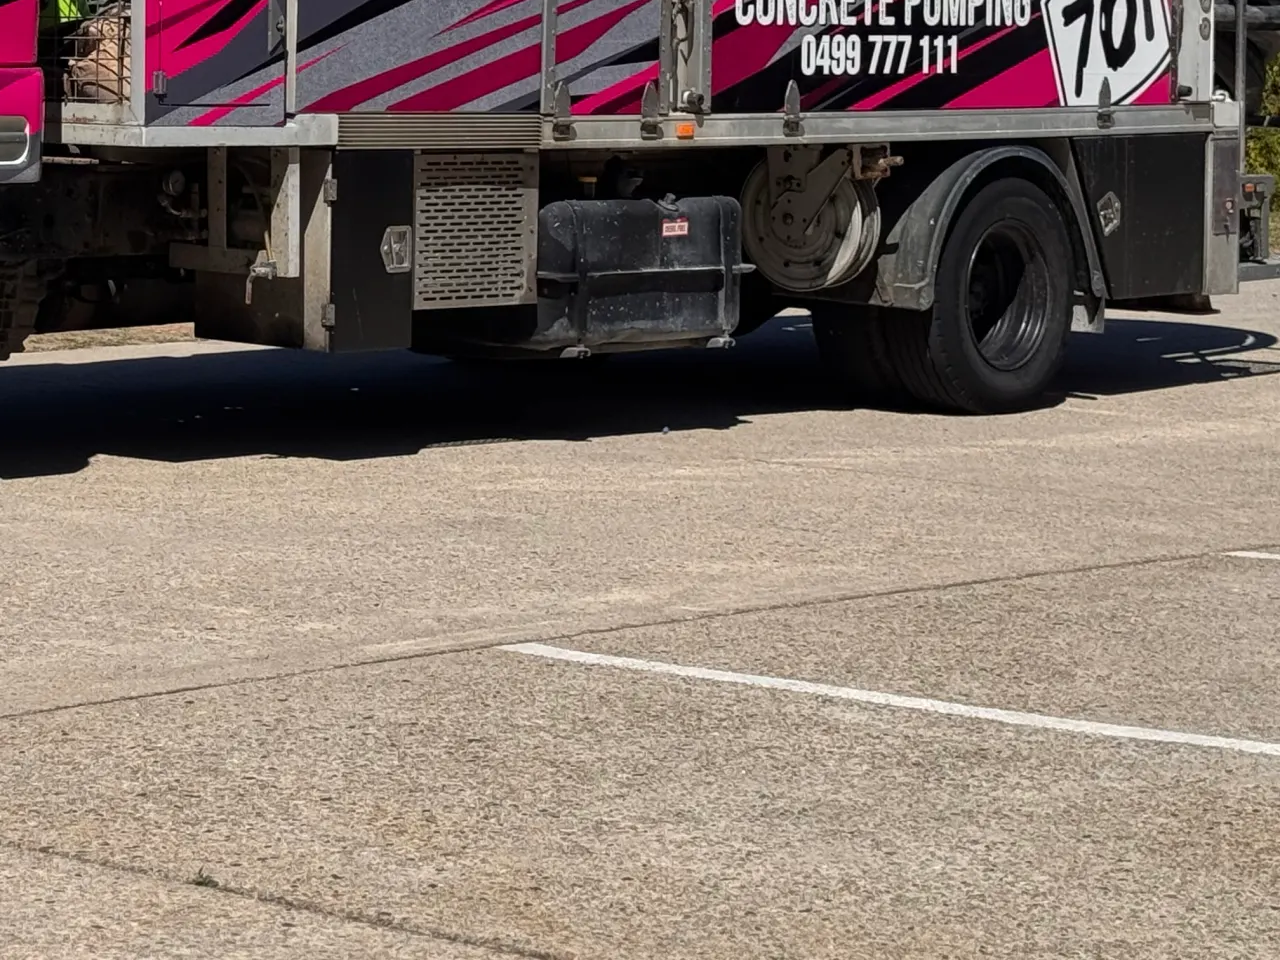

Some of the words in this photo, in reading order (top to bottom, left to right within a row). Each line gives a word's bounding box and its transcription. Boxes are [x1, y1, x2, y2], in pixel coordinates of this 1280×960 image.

[801, 34, 861, 76] 0499
[868, 35, 912, 75] 777
[919, 35, 958, 74] 111
